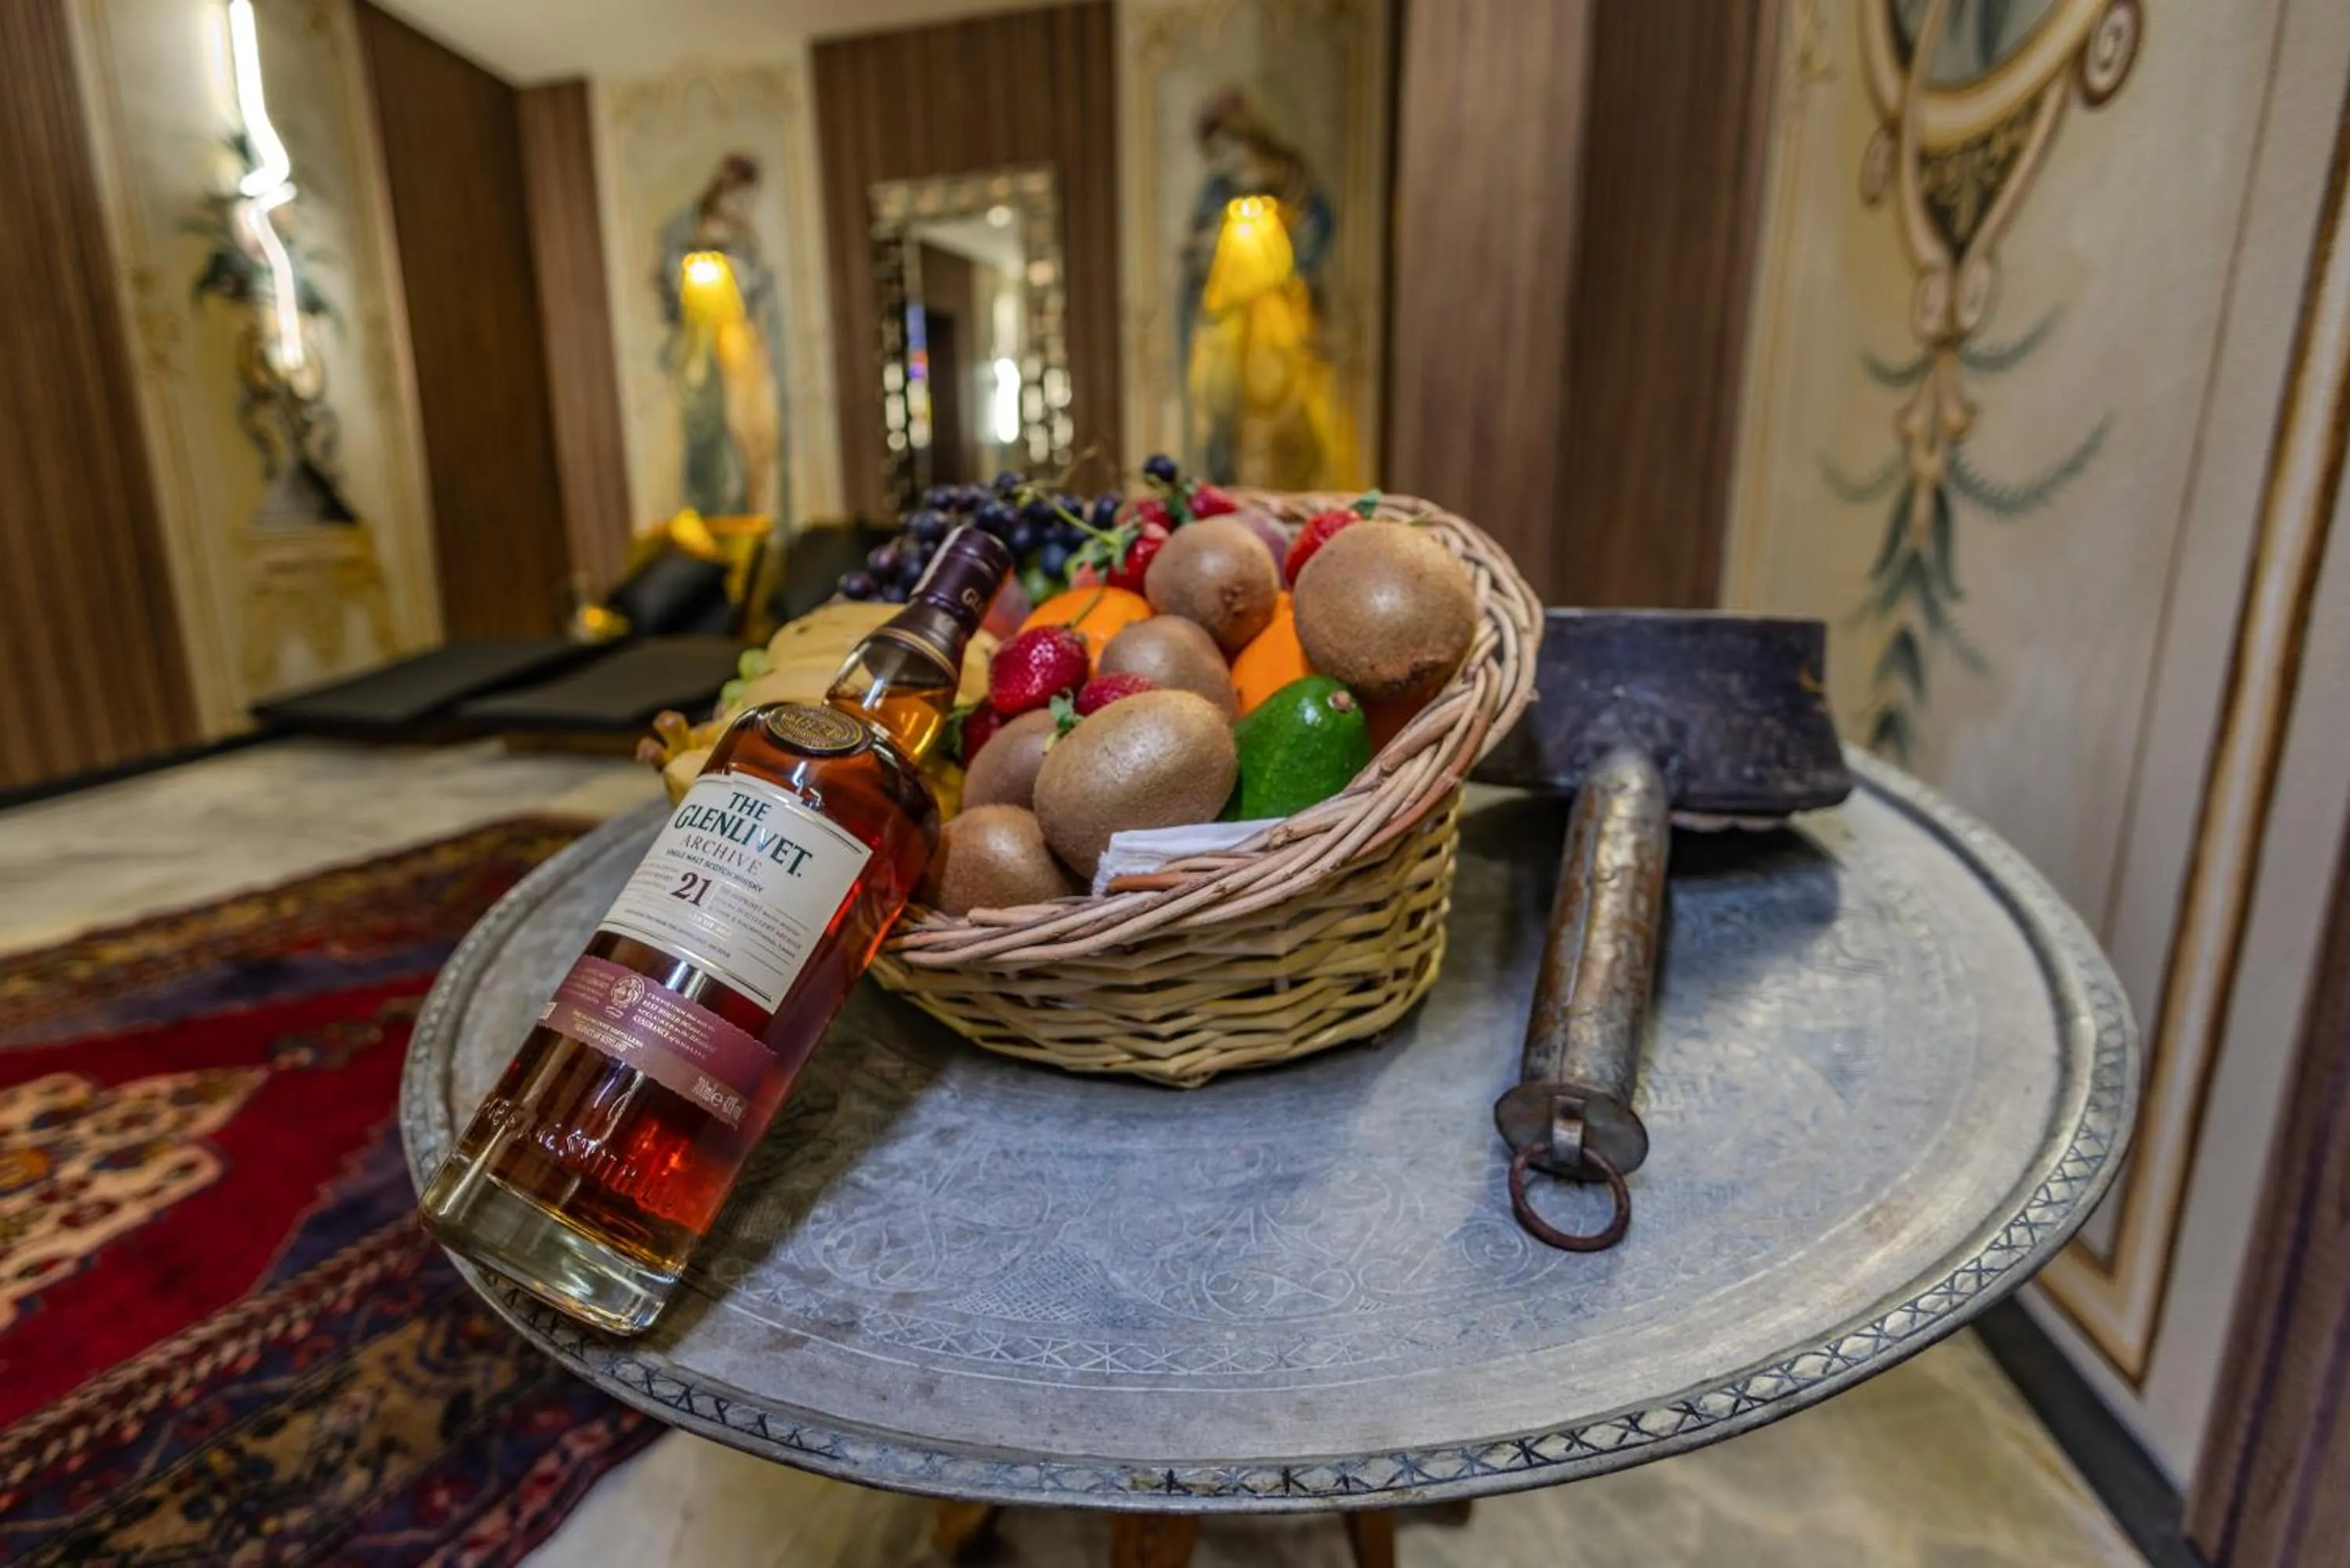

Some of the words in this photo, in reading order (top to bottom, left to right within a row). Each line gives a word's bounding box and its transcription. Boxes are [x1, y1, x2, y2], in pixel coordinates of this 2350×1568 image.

[728, 792, 771, 822] THE
[682, 834, 763, 876] ARCHIVE
[705, 860, 736, 878] SCOTCH
[671, 872, 713, 906] 21
